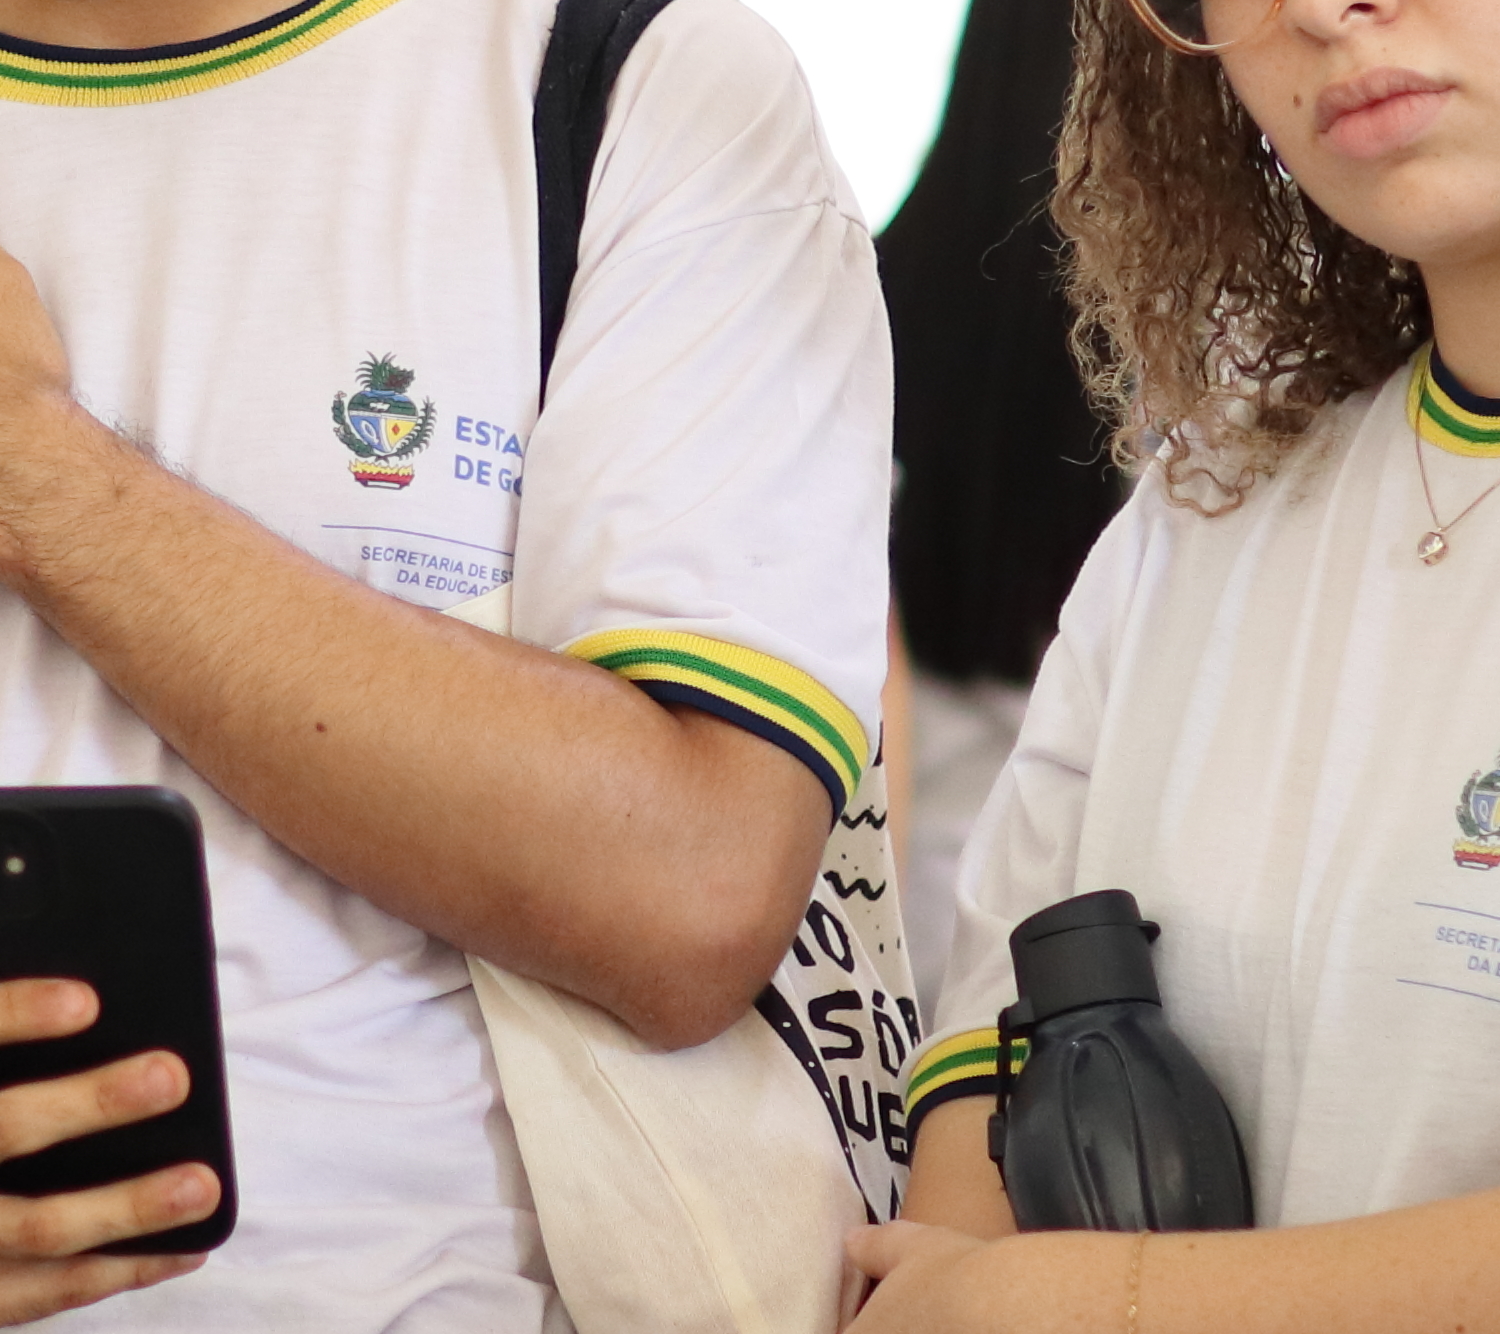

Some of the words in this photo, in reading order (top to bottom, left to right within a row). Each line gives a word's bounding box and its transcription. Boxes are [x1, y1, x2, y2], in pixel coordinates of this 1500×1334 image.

[456, 416, 524, 458] ESTA
[454, 454, 492, 487] DE
[361, 546, 464, 575] SECRETARIA
[468, 563, 487, 580] DE
[396, 569, 420, 586] DA
[1467, 954, 1491, 974] DA
